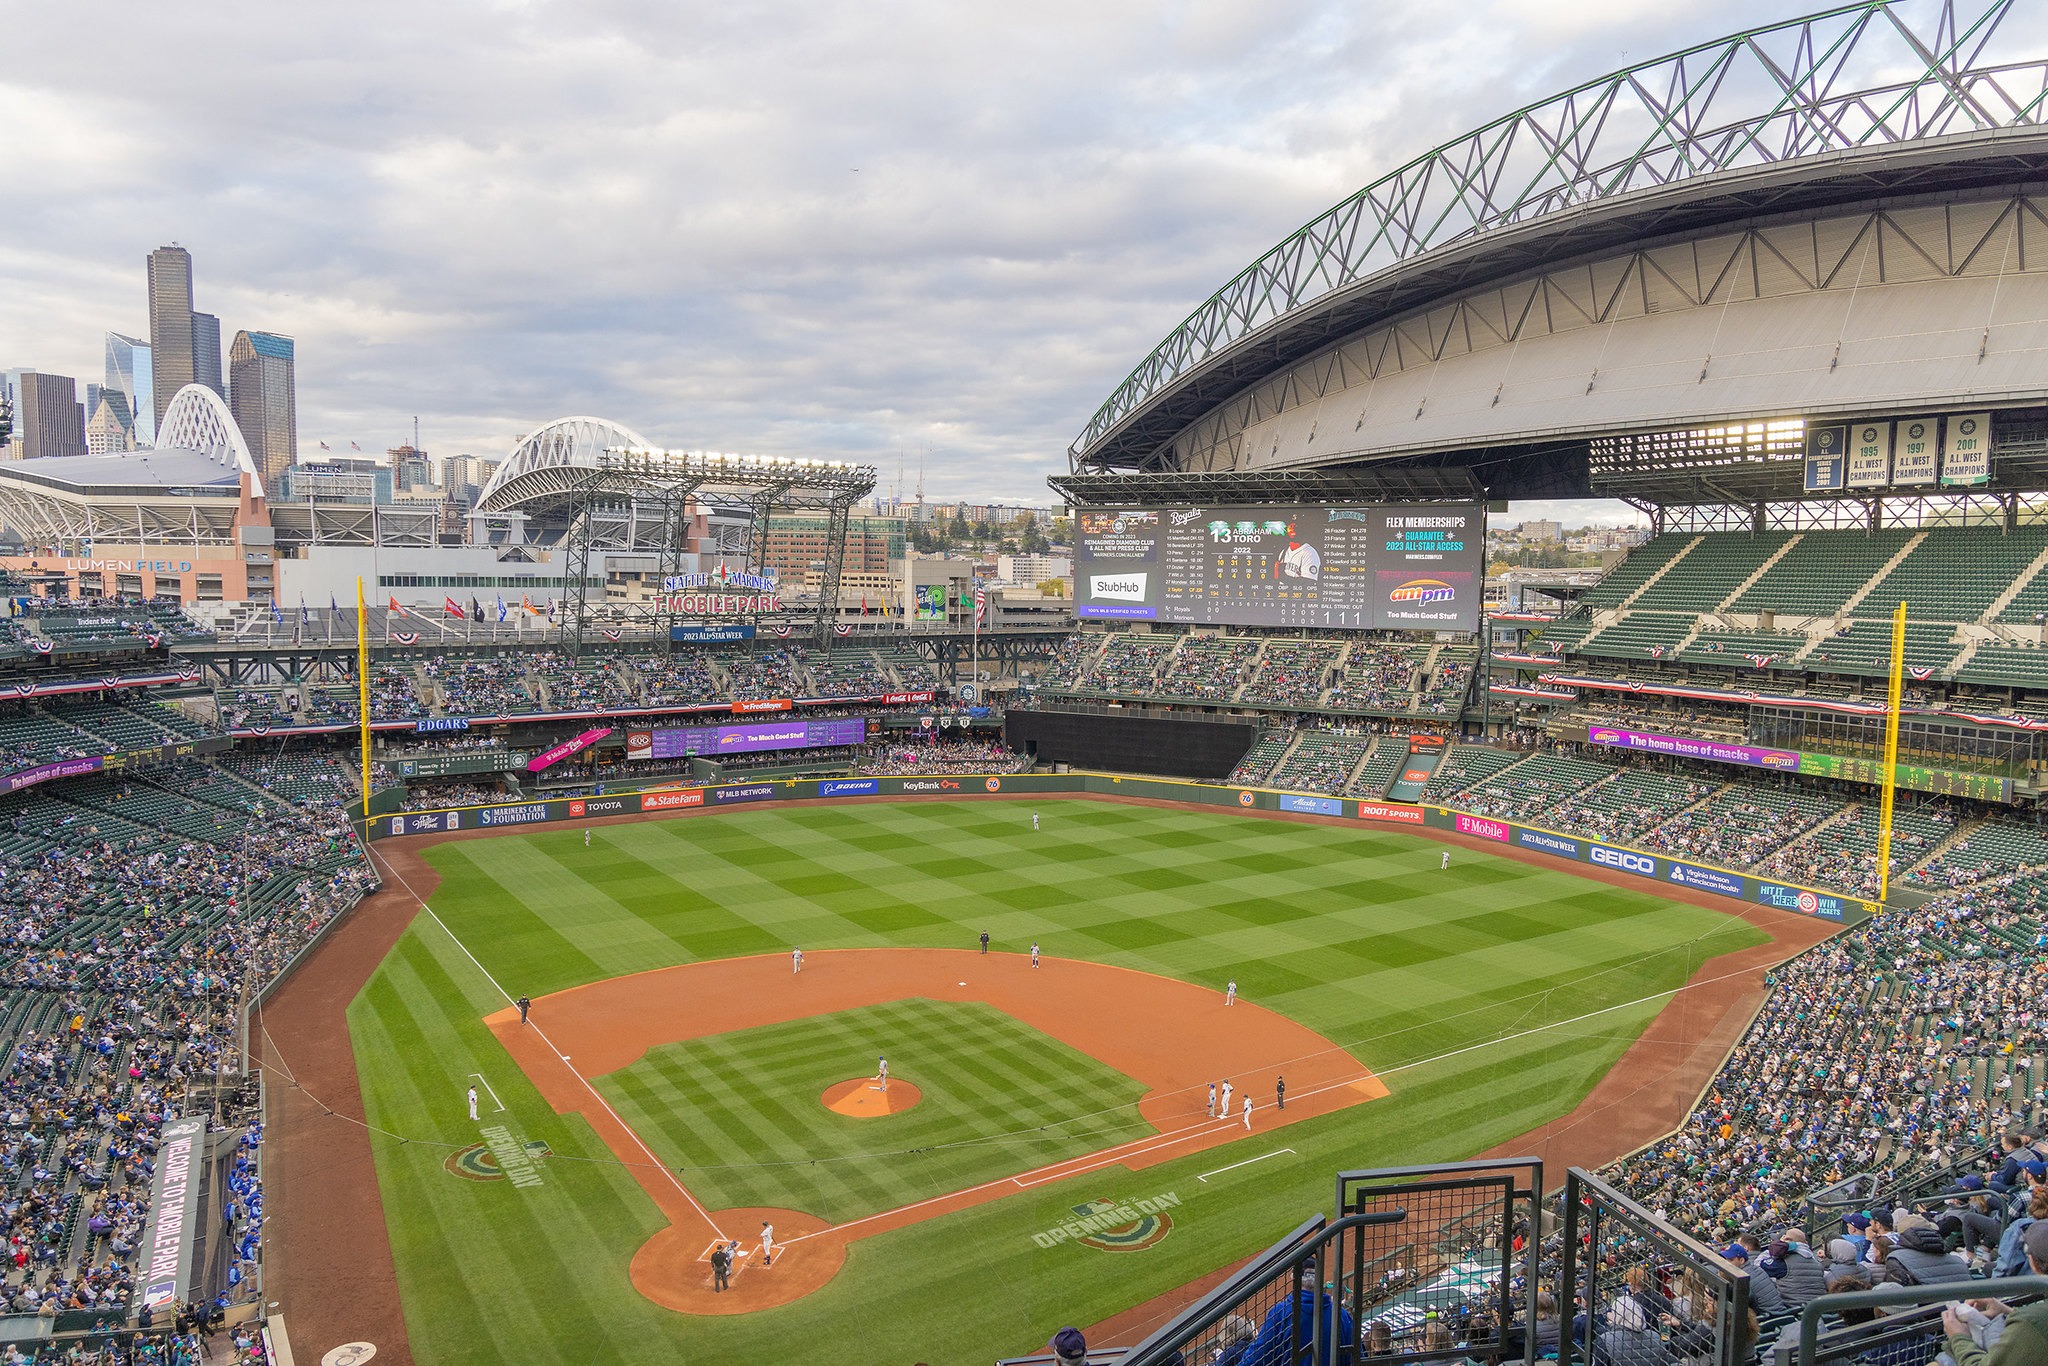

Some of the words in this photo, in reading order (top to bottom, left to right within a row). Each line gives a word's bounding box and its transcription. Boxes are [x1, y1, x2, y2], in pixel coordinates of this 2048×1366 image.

[1907, 443, 1924, 454] 1997
[1957, 439, 1977, 450] 2001
[1860, 446, 1878, 457] 1995
[1900, 458, 1910, 466] A.L.
[1912, 456, 1930, 466] WEST
[1950, 454, 1961, 463] A.L.
[1963, 452, 1982, 462] WEST
[1854, 460, 1864, 468] A.L.
[1866, 459, 1882, 468] WEST
[1850, 470, 1886, 481] CHAMPIONS
[1895, 468, 1933, 478] CHAMPIONS
[1945, 465, 1985, 476] CHAMPIONS
[1170, 508, 1202, 526] Royals
[1386, 518, 1404, 527] FLEX
[1405, 517, 1466, 527] MEMBERSHIPS
[1211, 528, 1231, 543] 13
[1405, 532, 1444, 540] GUARANTEE
[1386, 542, 1404, 550] 2023
[1406, 542, 1434, 550] ALL-STAR
[1436, 542, 1463, 550] ACCESS
[68, 560, 132, 571] LUMEN
[136, 561, 191, 572] FIELD
[665, 572, 708, 592] SEATTLE
[731, 572, 774, 592] MARINERS
[1097, 582, 1139, 592] StubHub
[1390, 587, 1455, 607] ampm
[650, 596, 733, 613] T-MOBILE
[736, 596, 782, 613] PARK
[1324, 611, 1330, 624] 1
[1339, 612, 1345, 624] 1
[1354, 612, 1360, 625] 1
[418, 719, 469, 732] EDGARS
[176, 746, 193, 755] MPH
[1594, 732, 1620, 743] ampm
[1629, 734, 1646, 747] The
[1648, 738, 1674, 749] home
[1676, 742, 1699, 754] base
[1700, 746, 1712, 755] of
[1713, 748, 1749, 760] snacks
[1762, 756, 1793, 768] ampm
[11, 778, 22, 789] The
[22, 773, 36, 786] home
[36, 770, 50, 781] base
[52, 766, 60, 776] of
[61, 762, 93, 775] snacks
[740, 787, 772, 795] NETWORK
[904, 781, 939, 790] KeyBank
[587, 801, 622, 810] TOYOTA
[1292, 798, 1317, 808] Alaska
[494, 807, 526, 816] MARINERS
[528, 805, 545, 813] CARE
[1364, 806, 1388, 816] ROOT
[494, 812, 546, 824] FOUNDATION
[1471, 820, 1502, 838] Mobile
[1522, 833, 1534, 843] 2023
[1560, 841, 1576, 852] WEEK
[1590, 847, 1654, 873] GEICO
[1686, 869, 1708, 880] Virginia
[1709, 874, 1730, 884] Mason
[1686, 876, 1718, 888] Franciscan
[1719, 882, 1739, 893] Health
[1760, 886, 1775, 895] HIT
[1775, 888, 1784, 896] IT
[1775, 896, 1796, 906] HERE
[1819, 899, 1836, 908] WIN
[1818, 907, 1840, 915] TICKETS
[1862, 903, 1876, 912] 326
[164, 1136, 192, 1184] WELCOME
[479, 1126, 530, 1168] OPENING
[506, 1166, 544, 1188] DAY
[161, 1183, 186, 1199] TO
[1056, 1216, 1076, 1224] 20
[1119, 1196, 1138, 1205] 22
[154, 1199, 185, 1248] T-MOBILE
[1031, 1206, 1140, 1249] OPENING
[1136, 1192, 1182, 1215] DAY
[150, 1249, 180, 1282] PARK
